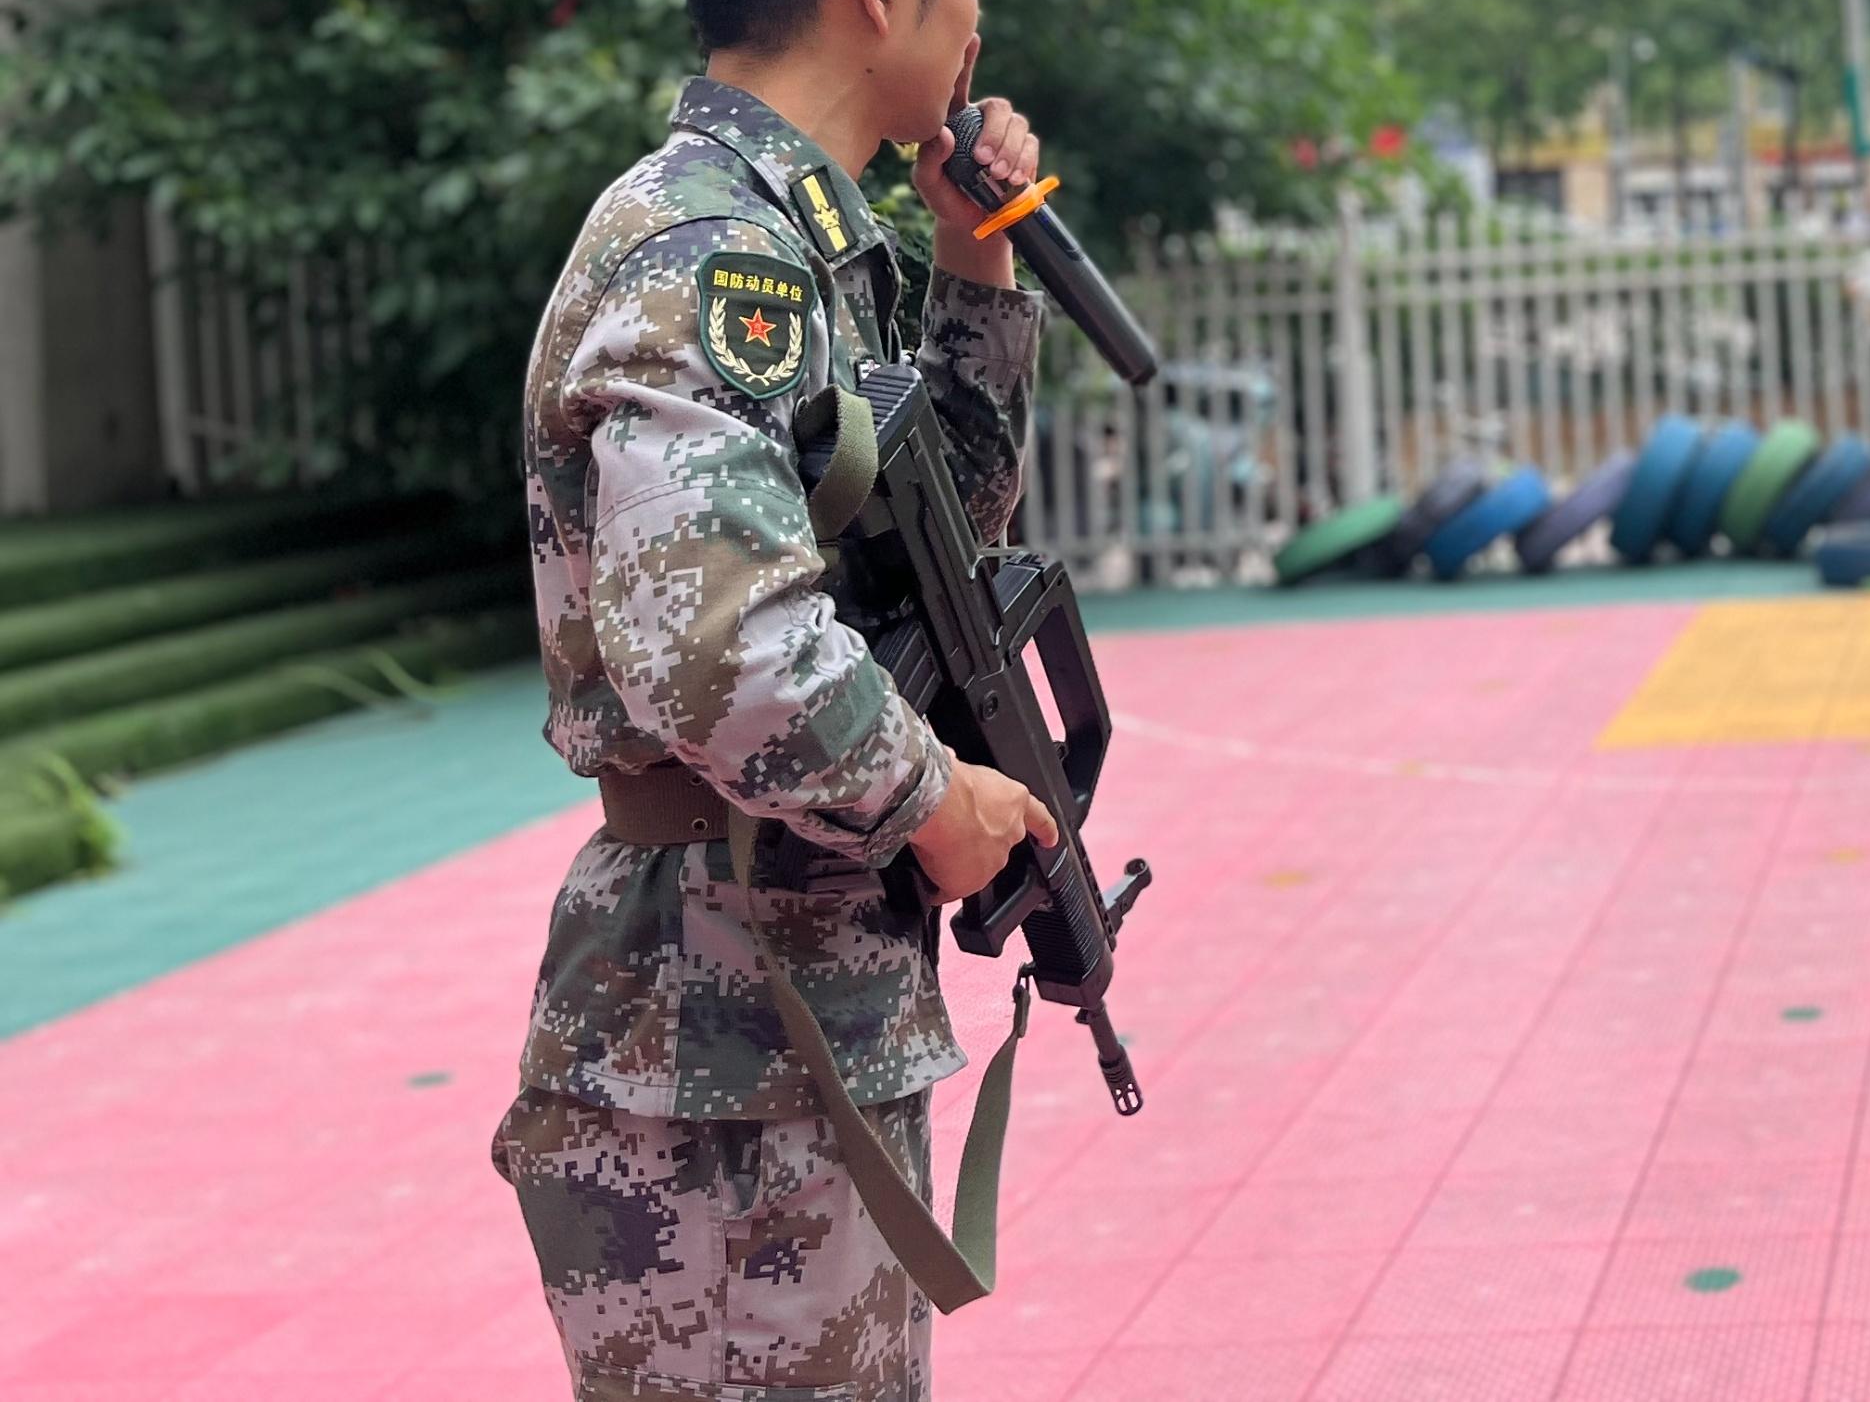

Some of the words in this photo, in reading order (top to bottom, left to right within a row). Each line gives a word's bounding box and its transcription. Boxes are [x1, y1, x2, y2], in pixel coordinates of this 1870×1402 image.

[713, 269, 804, 302] 国防动员单位
